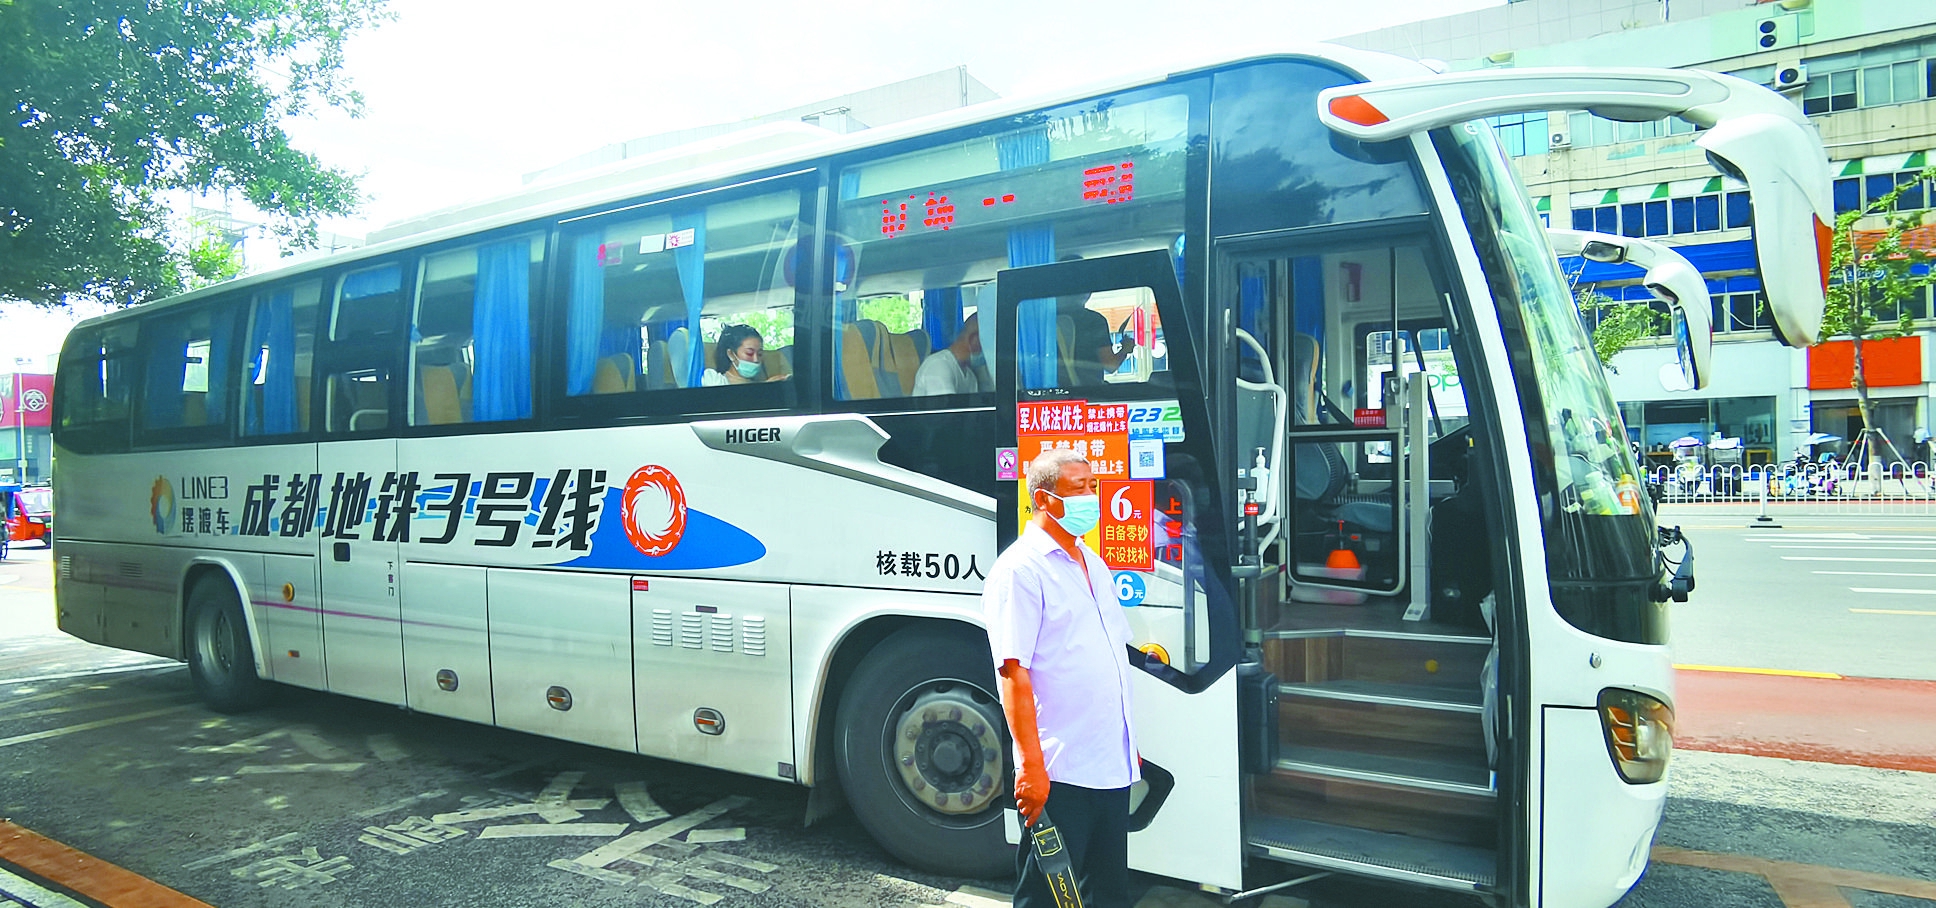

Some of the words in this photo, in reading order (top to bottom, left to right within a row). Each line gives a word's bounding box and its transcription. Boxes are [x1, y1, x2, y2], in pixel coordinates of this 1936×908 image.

[1020, 405, 1083, 432] 军人依法优先
[1088, 407, 1125, 420] 禁止携带
[726, 428, 781, 443] HIGER
[182, 507, 230, 534] 摆渡车
[239, 468, 607, 551] 成都地铁3号线
[1105, 525, 1149, 542] 自备零钞
[876, 550, 986, 581] 核载50人
[1105, 546, 1149, 564] 不设找补
